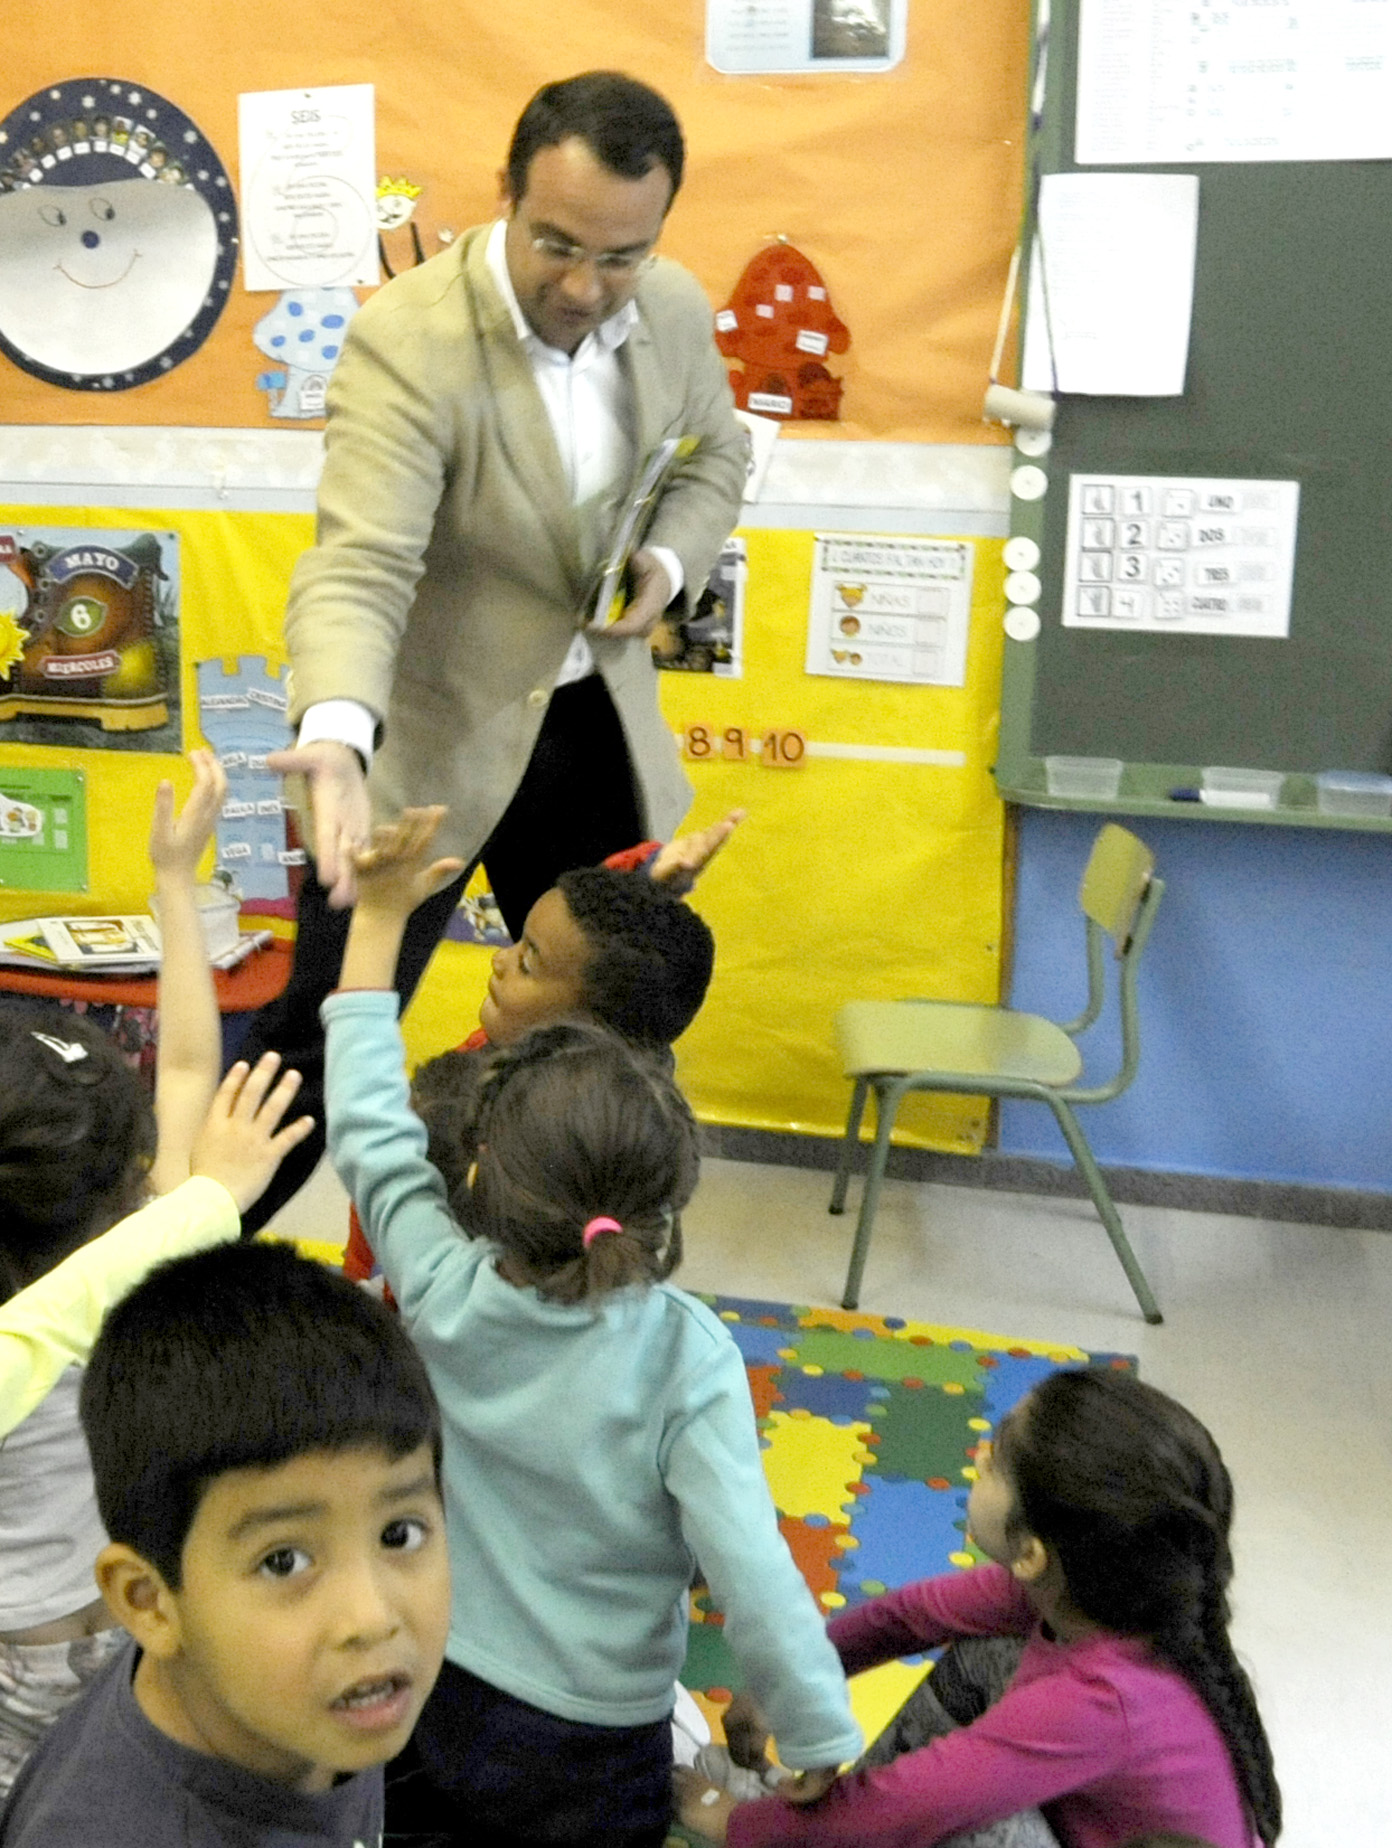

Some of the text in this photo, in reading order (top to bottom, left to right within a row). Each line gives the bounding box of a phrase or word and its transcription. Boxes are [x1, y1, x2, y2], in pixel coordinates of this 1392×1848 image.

[1130, 490, 1143, 513] 1
[1126, 523, 1143, 546] 2
[63, 552, 121, 571] MAYO
[1125, 556, 1141, 578] 3
[70, 603, 92, 629] 6
[687, 726, 805, 762] 8 9 10
